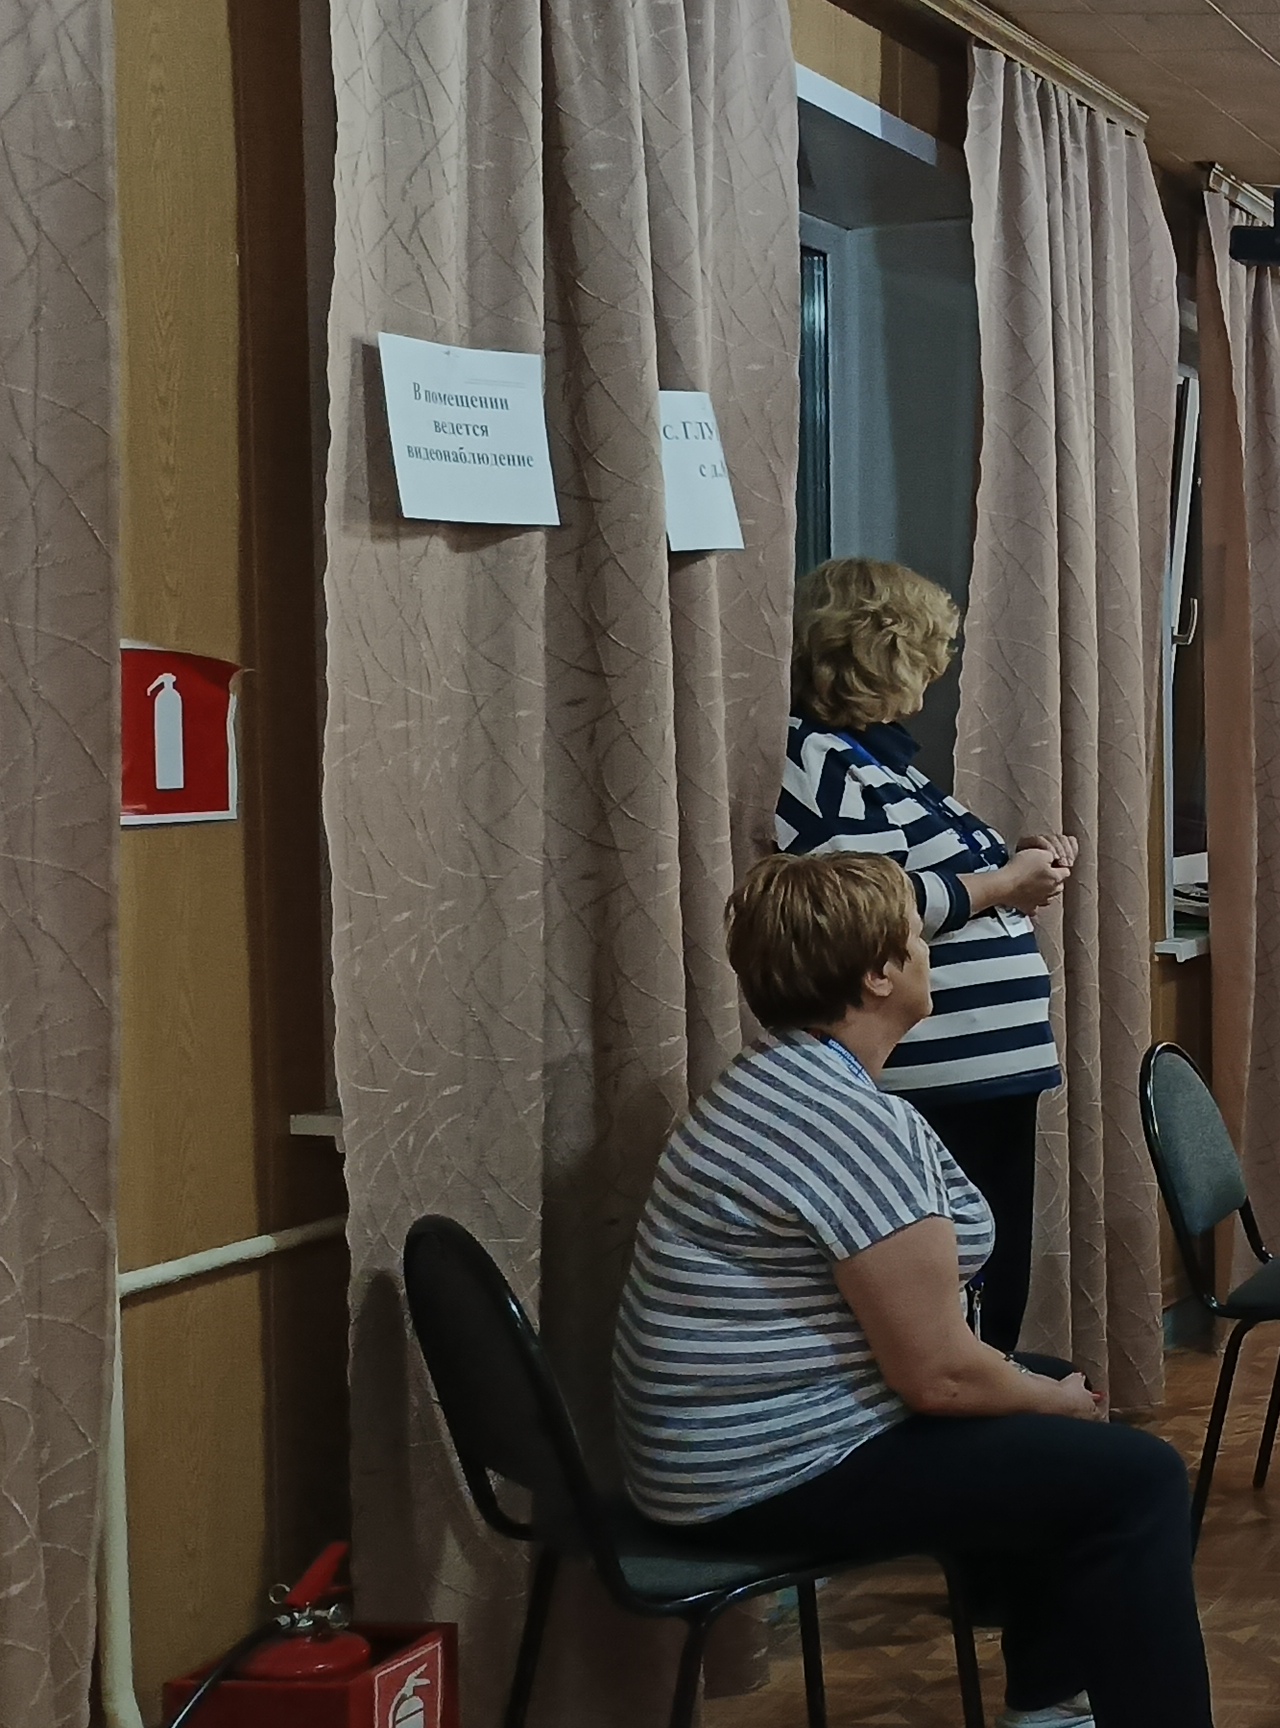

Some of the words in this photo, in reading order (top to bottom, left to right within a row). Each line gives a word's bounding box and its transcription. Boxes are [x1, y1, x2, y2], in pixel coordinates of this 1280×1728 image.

[412, 381, 422, 401] В
[424, 389, 510, 411] помещении
[433, 420, 490, 437] ведется
[681, 421, 719, 440] ГЛУ
[406, 445, 535, 468] видеонаблюдение
